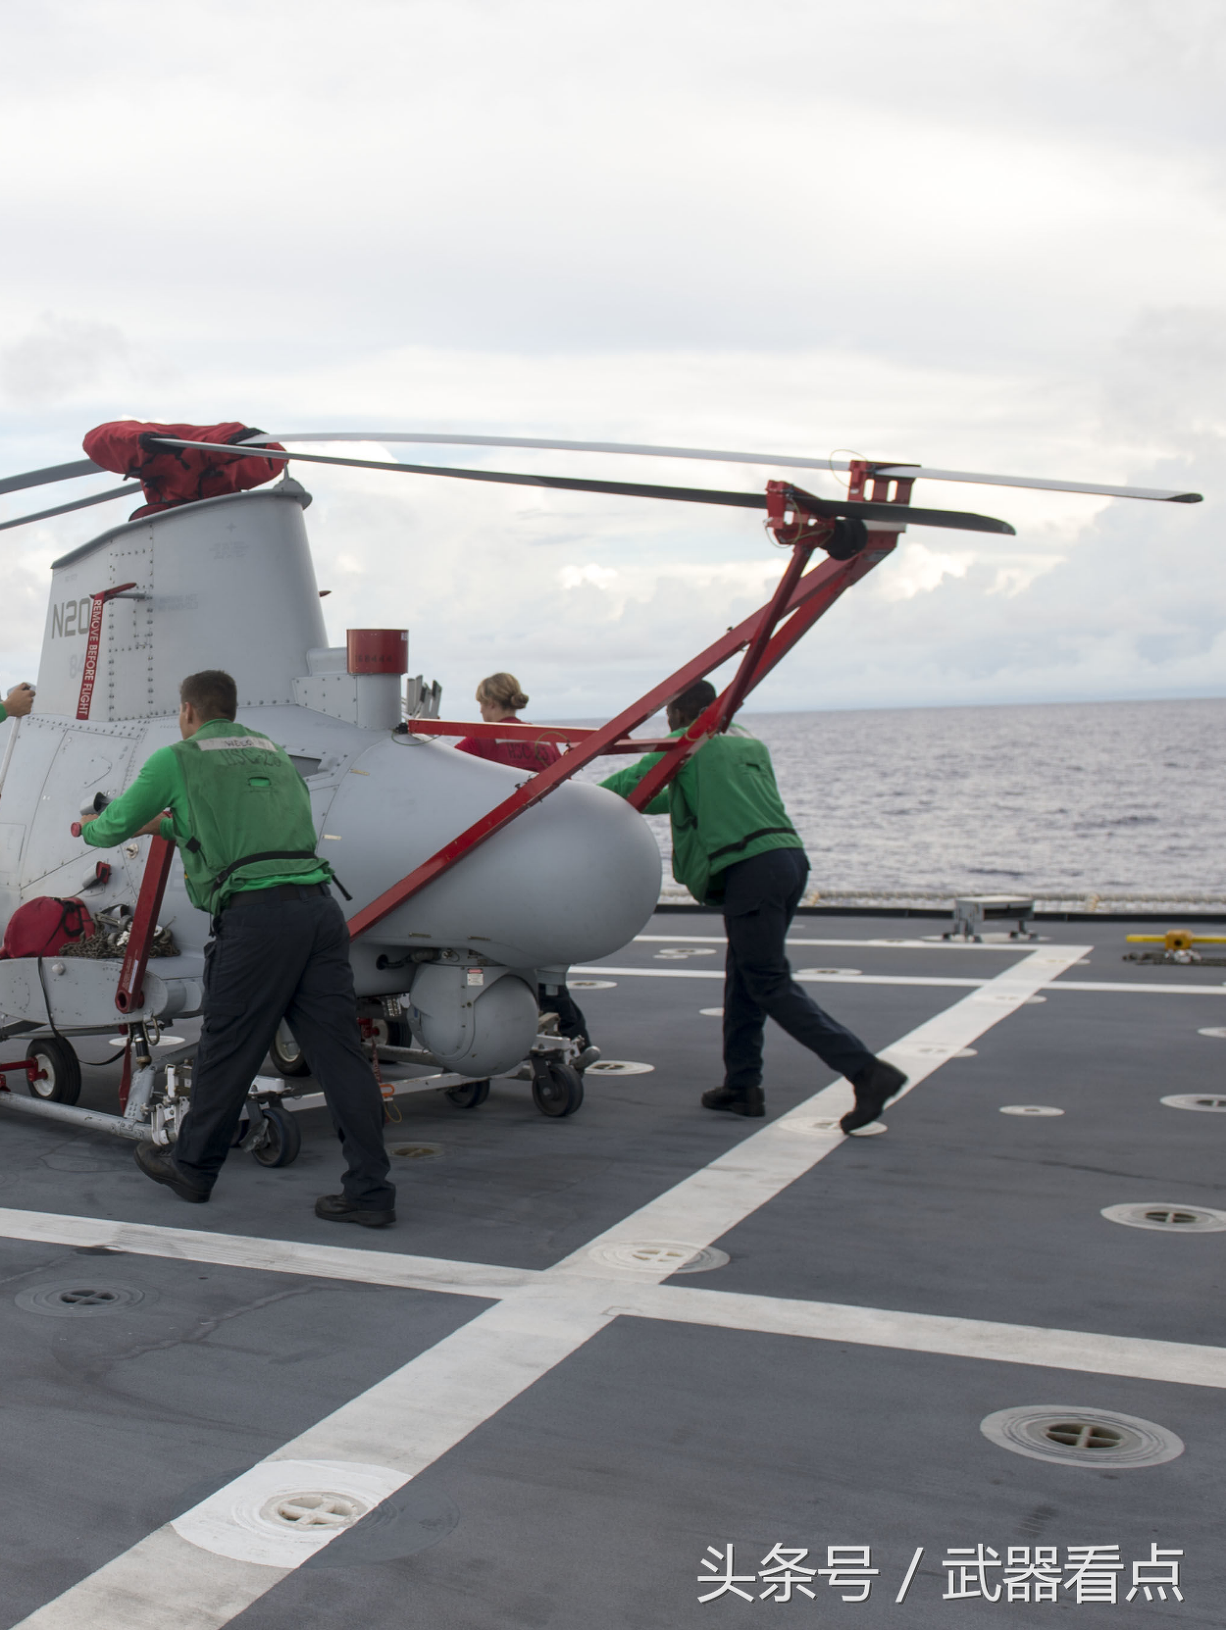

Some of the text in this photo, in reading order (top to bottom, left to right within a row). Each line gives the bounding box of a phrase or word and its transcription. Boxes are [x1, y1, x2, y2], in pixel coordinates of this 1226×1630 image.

[51, 597, 91, 640] N20
[78, 599, 103, 716] REMOVE BEFORE FLIGHT
